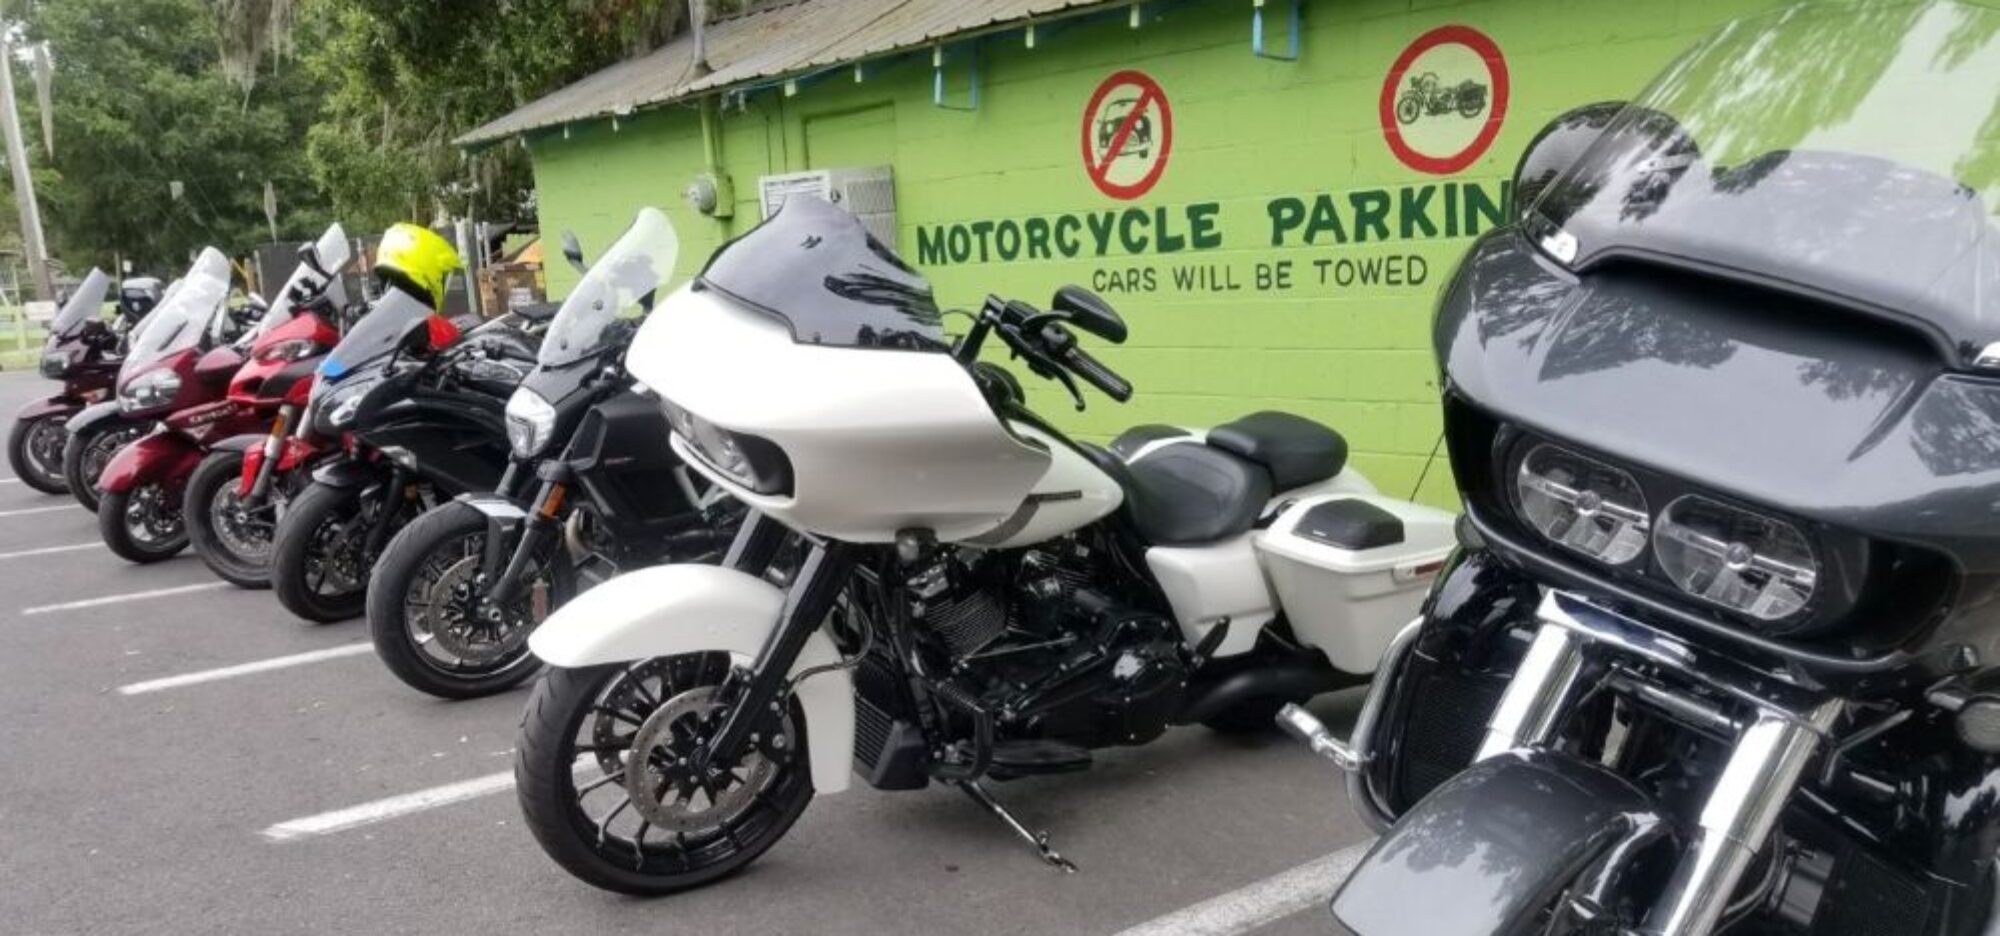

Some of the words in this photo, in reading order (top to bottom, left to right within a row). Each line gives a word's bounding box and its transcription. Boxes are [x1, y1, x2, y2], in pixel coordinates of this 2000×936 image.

[917, 202, 1222, 266] MOTORCYCLE
[1267, 180, 1512, 247] PARKIN
[1092, 266, 1157, 293] CARS
[1173, 264, 1242, 291] WILL
[1256, 260, 1293, 290] BE
[1313, 255, 1428, 286] TOWED
